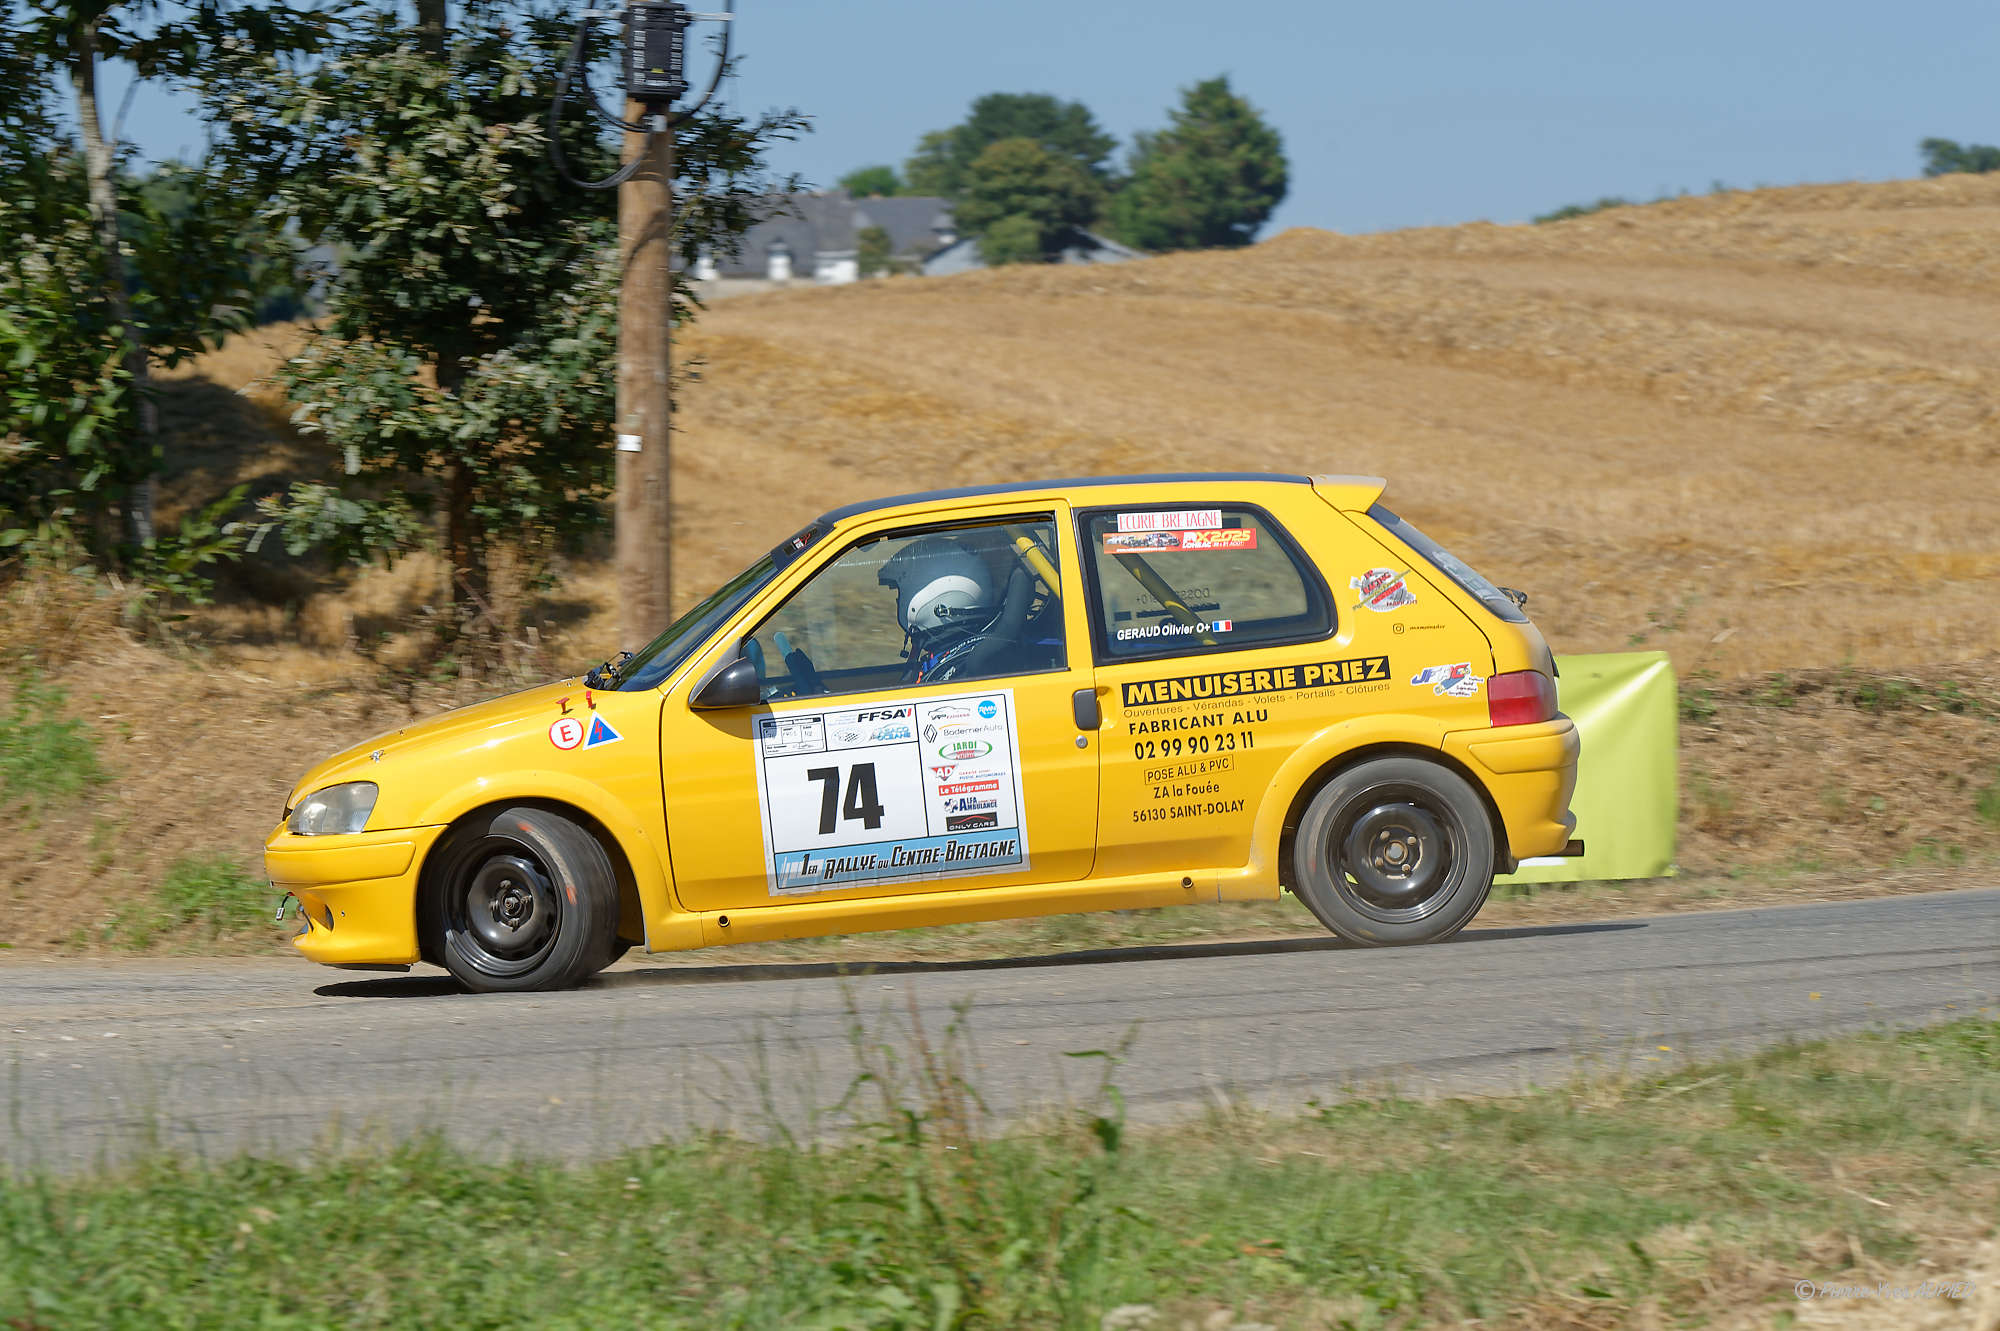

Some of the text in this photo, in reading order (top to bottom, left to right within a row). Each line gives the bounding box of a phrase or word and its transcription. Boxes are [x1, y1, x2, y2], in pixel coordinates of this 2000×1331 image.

[1162, 511, 1220, 529] BRETAGNE
[1117, 622, 1211, 641] GERAUD Olivier O+
[1127, 658, 1386, 705] MENUISERIE PRIEZ
[1123, 681, 1391, 718] Ouvertures Vérandas Volets Portails Clôtures
[857, 708, 906, 723] FFSA
[1129, 709, 1269, 736] FABRICANT ALU
[560, 725, 574, 742] E
[1134, 731, 1255, 760] 02 99 90 23 11
[936, 767, 953, 777] AD
[1147, 757, 1230, 782] POSE ALU & PVC
[807, 762, 885, 835] 74
[940, 782, 997, 795] Le Télégramme
[1153, 781, 1220, 800] ZA la Fouée
[1133, 799, 1246, 823] 56130 SAINT-DOLAY
[949, 822, 971, 831] ONLY
[824, 854, 877, 880] RALLYE
[878, 860, 889, 869] DU
[890, 840, 1016, 868] CENTRE-BRETAGNE
